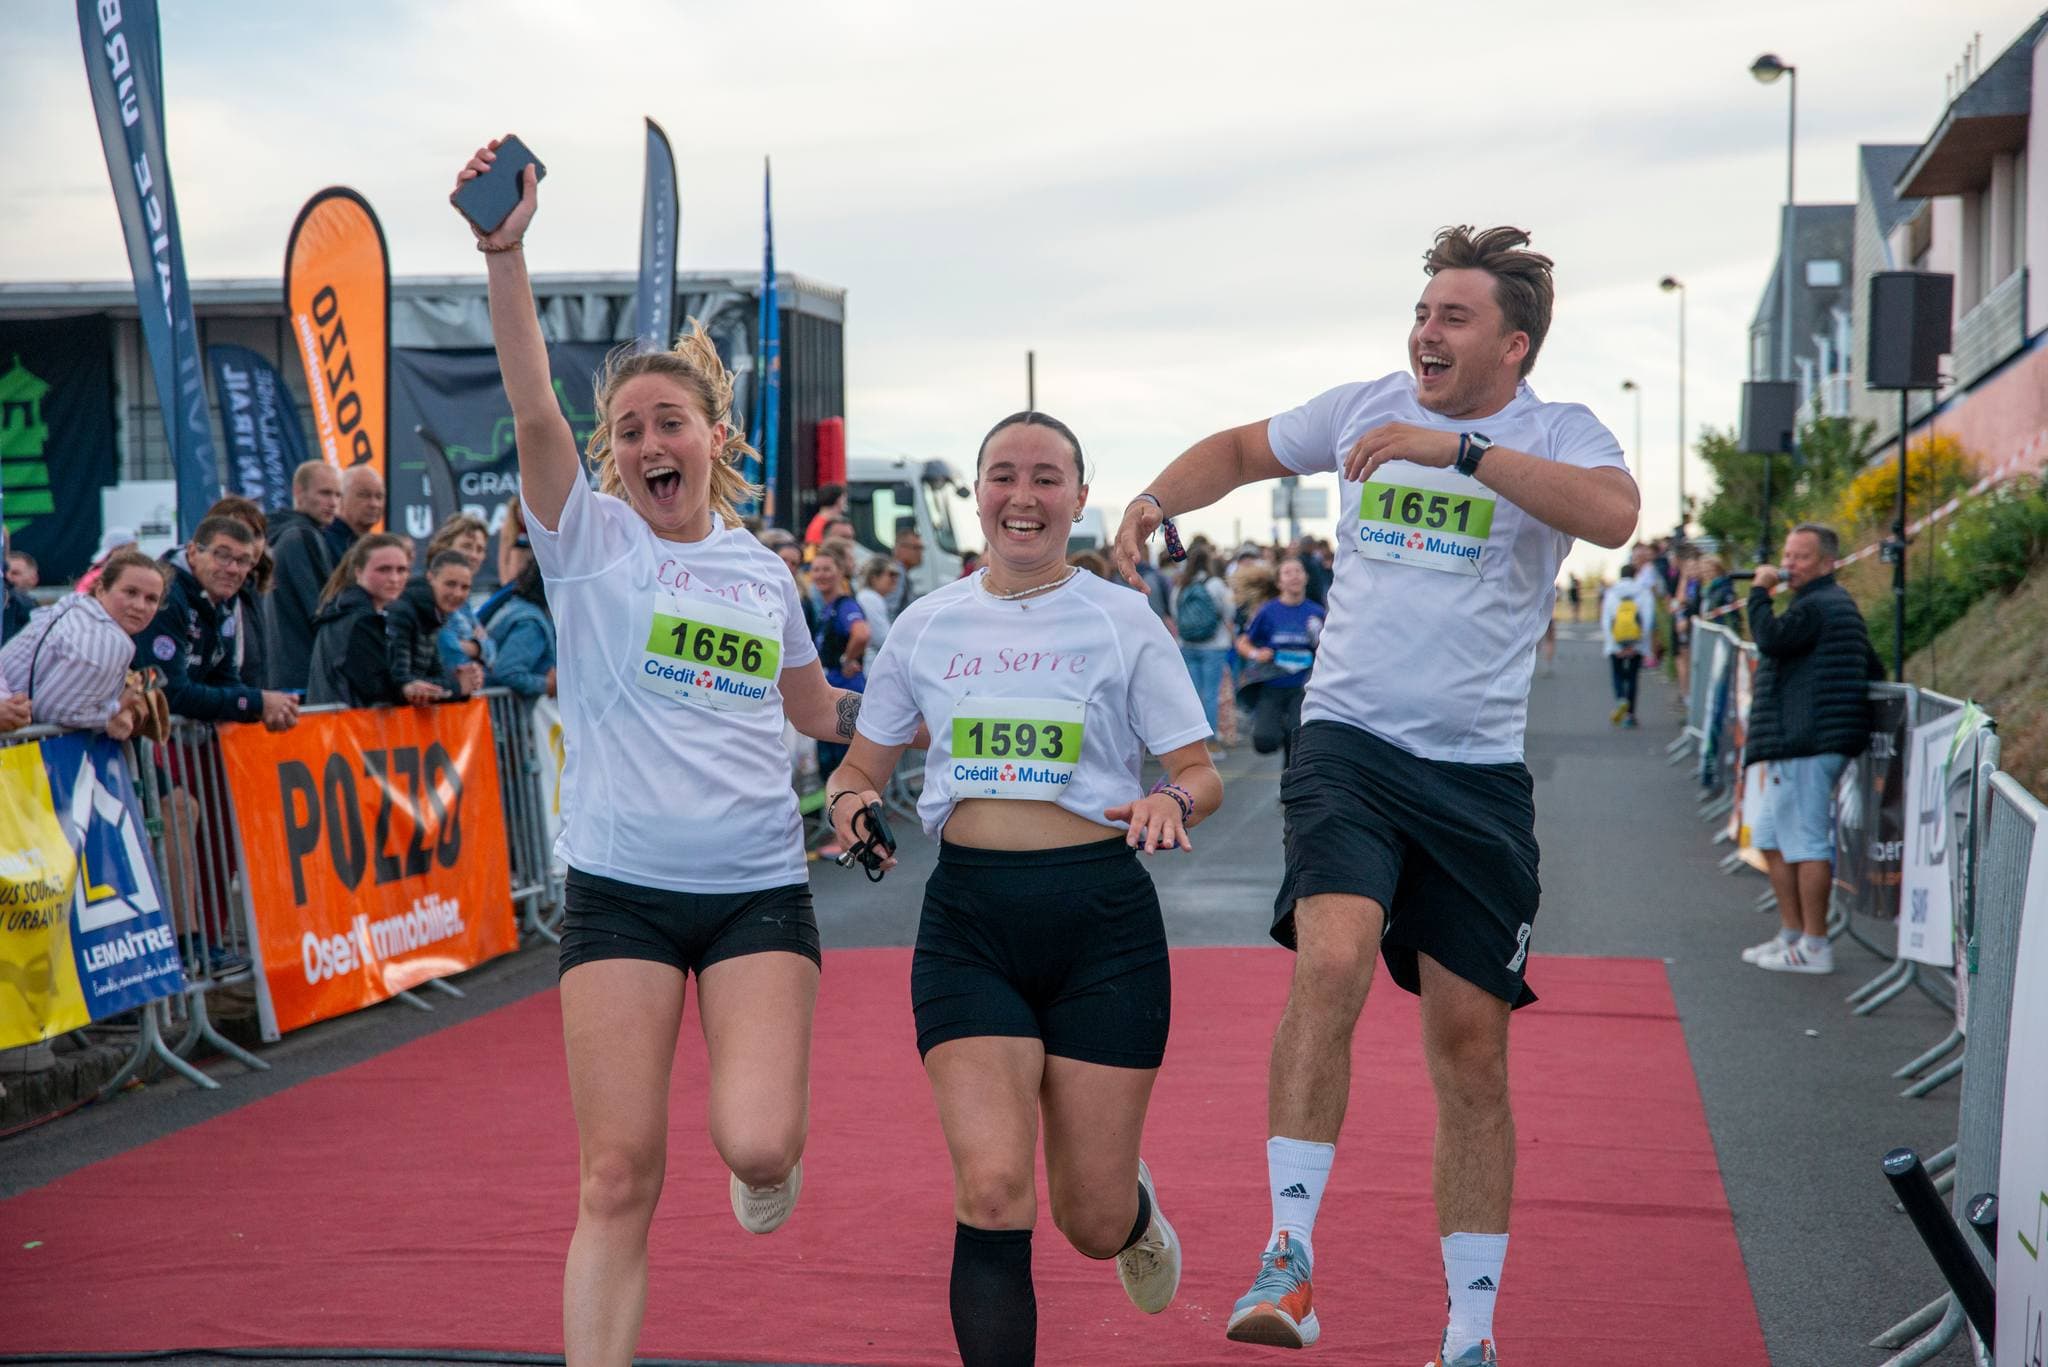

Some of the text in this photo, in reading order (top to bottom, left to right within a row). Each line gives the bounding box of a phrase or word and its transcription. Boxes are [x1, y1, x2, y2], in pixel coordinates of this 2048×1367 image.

[460, 472, 519, 496] GRA
[1378, 487, 1472, 532] 1651
[1360, 526, 1405, 547] Crédit
[1425, 537, 1482, 560] Mutuel
[671, 622, 764, 673] 1656
[943, 648, 1087, 681] La Serre
[644, 659, 768, 700] Crédit Mutuel
[968, 722, 1064, 759] 1593
[954, 764, 1073, 785] Crédit Mutuel
[277, 741, 463, 906] POZZO
[82, 923, 175, 973] LEMAÎTRE
[1280, 1191, 1311, 1200] adidas
[1468, 1284, 1497, 1292] adidas
